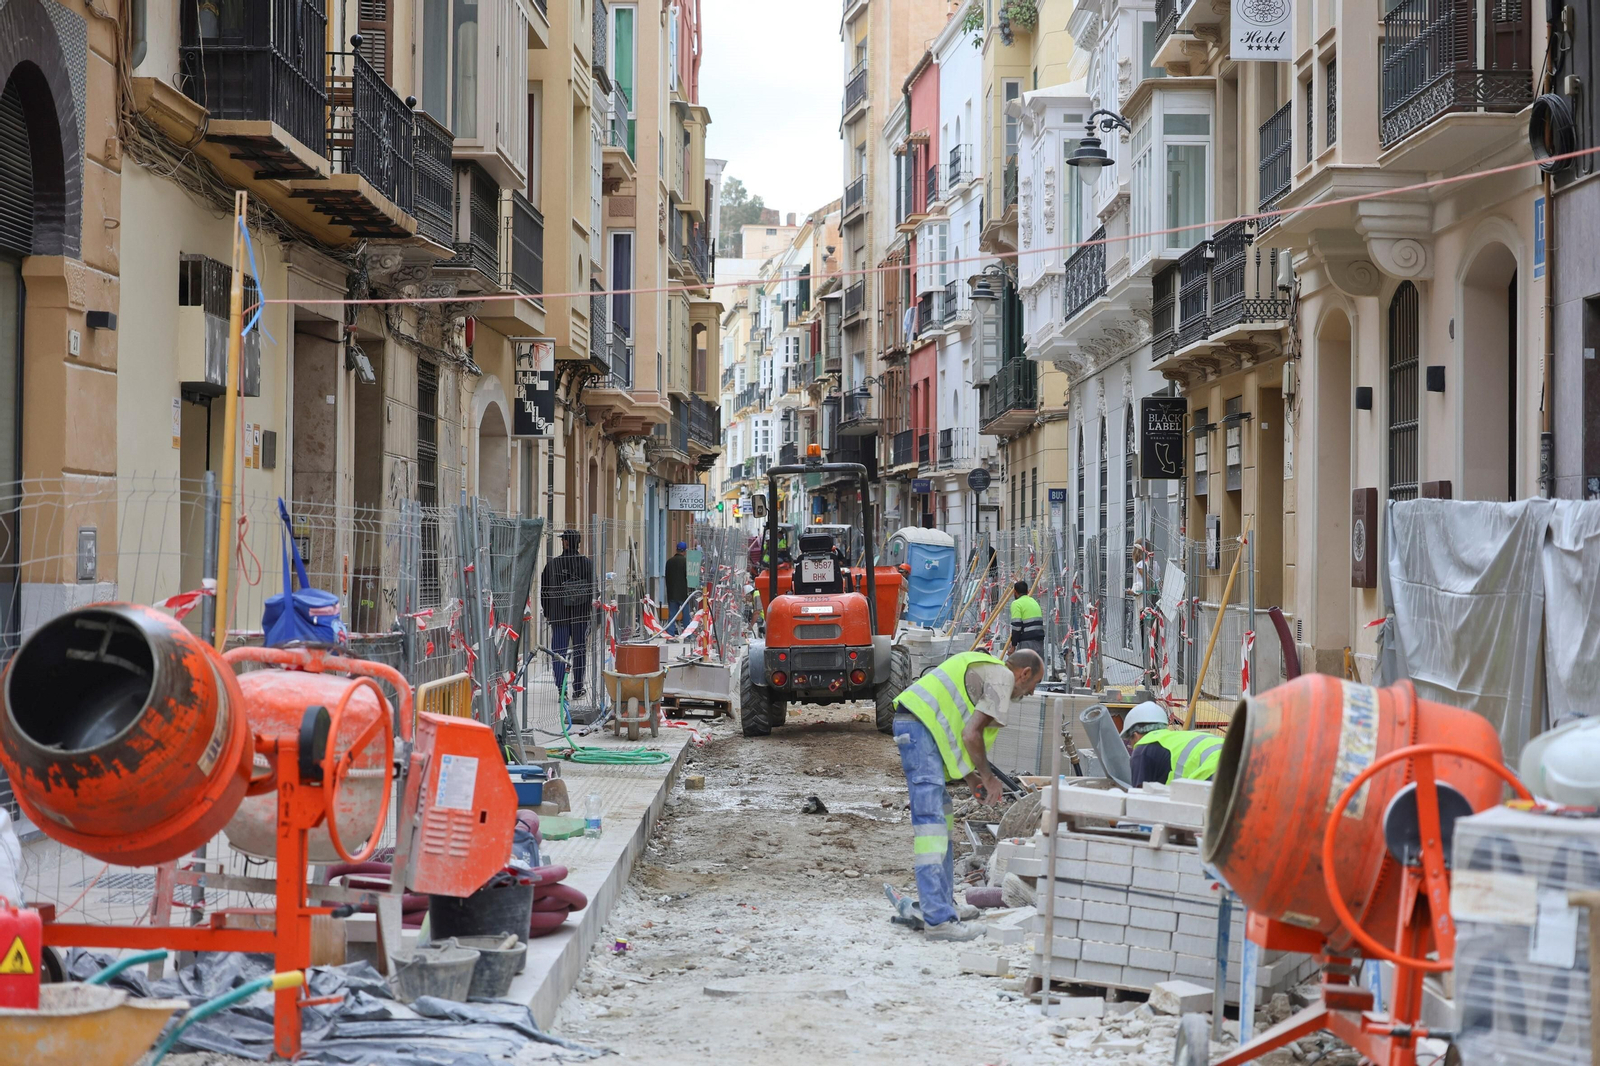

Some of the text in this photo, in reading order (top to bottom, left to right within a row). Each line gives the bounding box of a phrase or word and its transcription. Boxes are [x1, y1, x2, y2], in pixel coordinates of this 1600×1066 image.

[1240, 30, 1286, 44] Hotel
[1148, 413, 1182, 422] BLACK
[1148, 423, 1182, 431] LABEL
[1052, 491, 1063, 499] BUS
[814, 562, 832, 570] 9587
[812, 573, 827, 581] BHK
